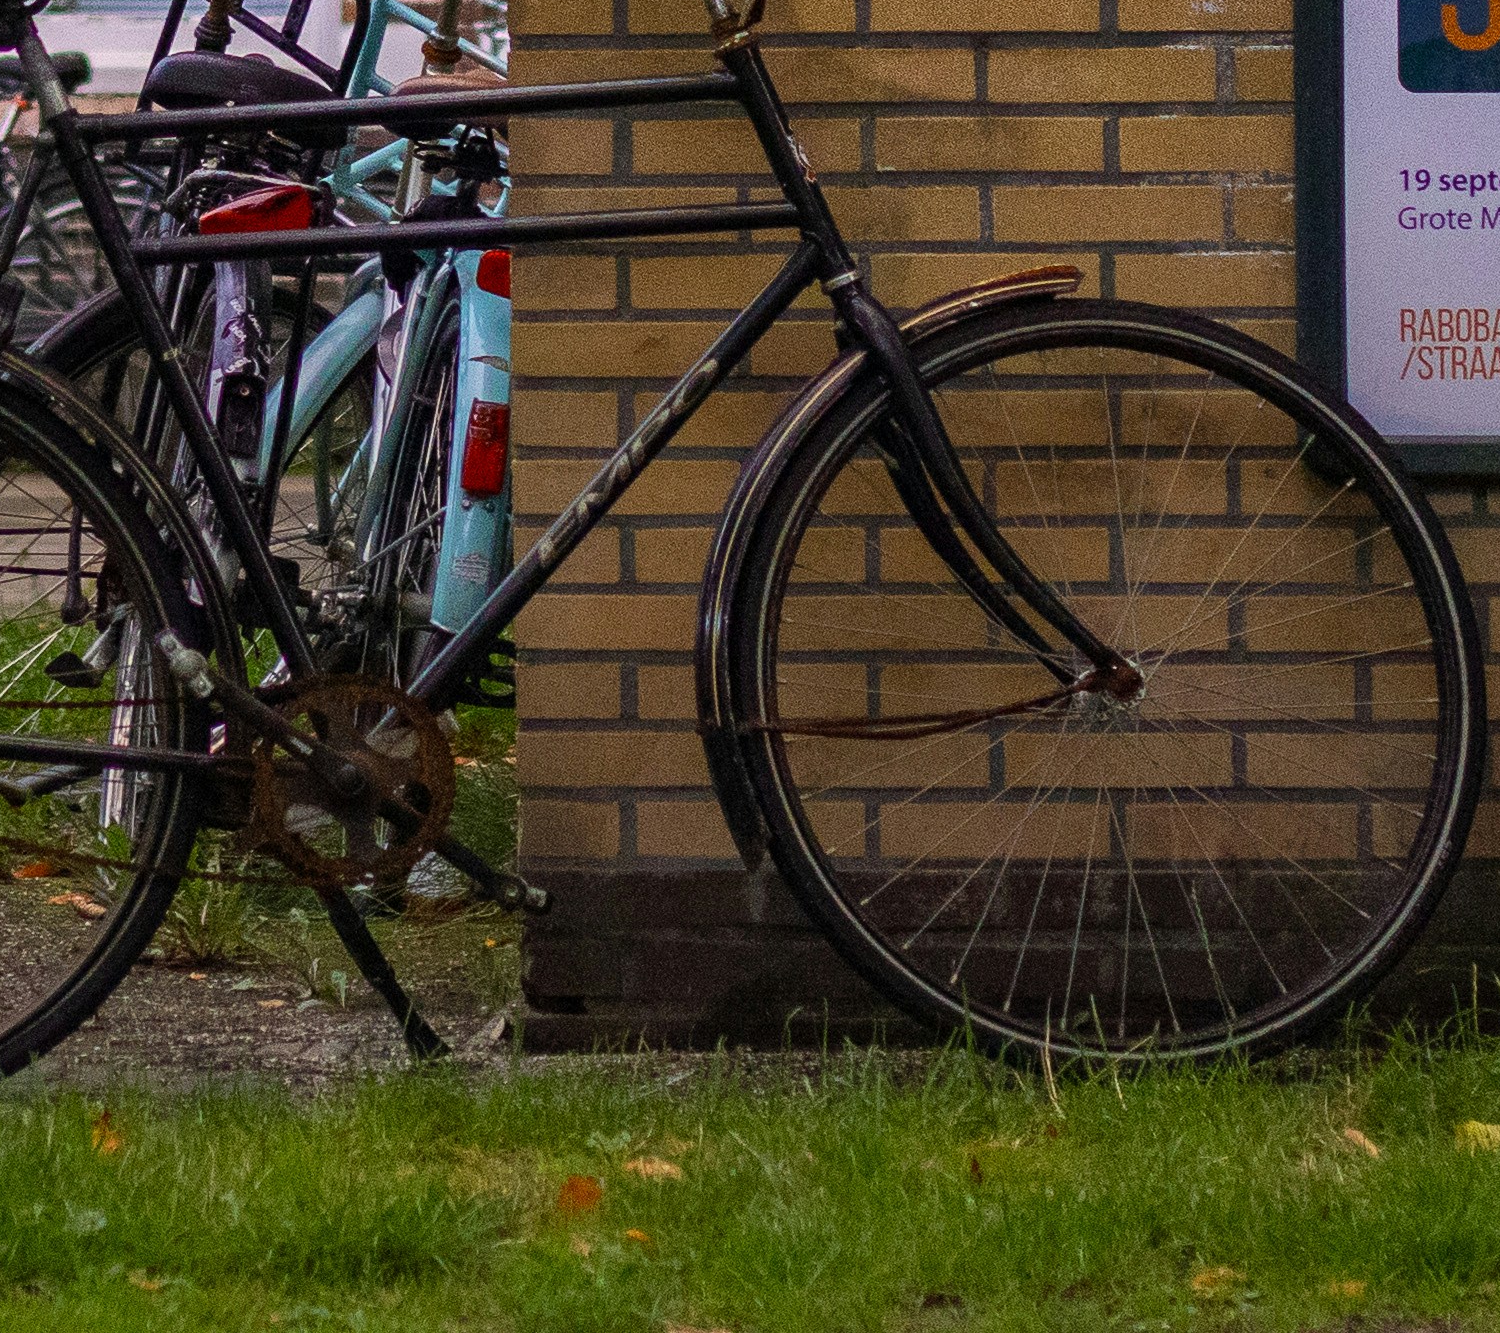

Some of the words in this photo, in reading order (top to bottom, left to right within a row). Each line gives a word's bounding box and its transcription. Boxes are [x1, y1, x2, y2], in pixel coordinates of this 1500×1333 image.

[1399, 169, 1431, 191] 19
[1398, 206, 1472, 230] Grote
[538, 357, 719, 566] EMPO
